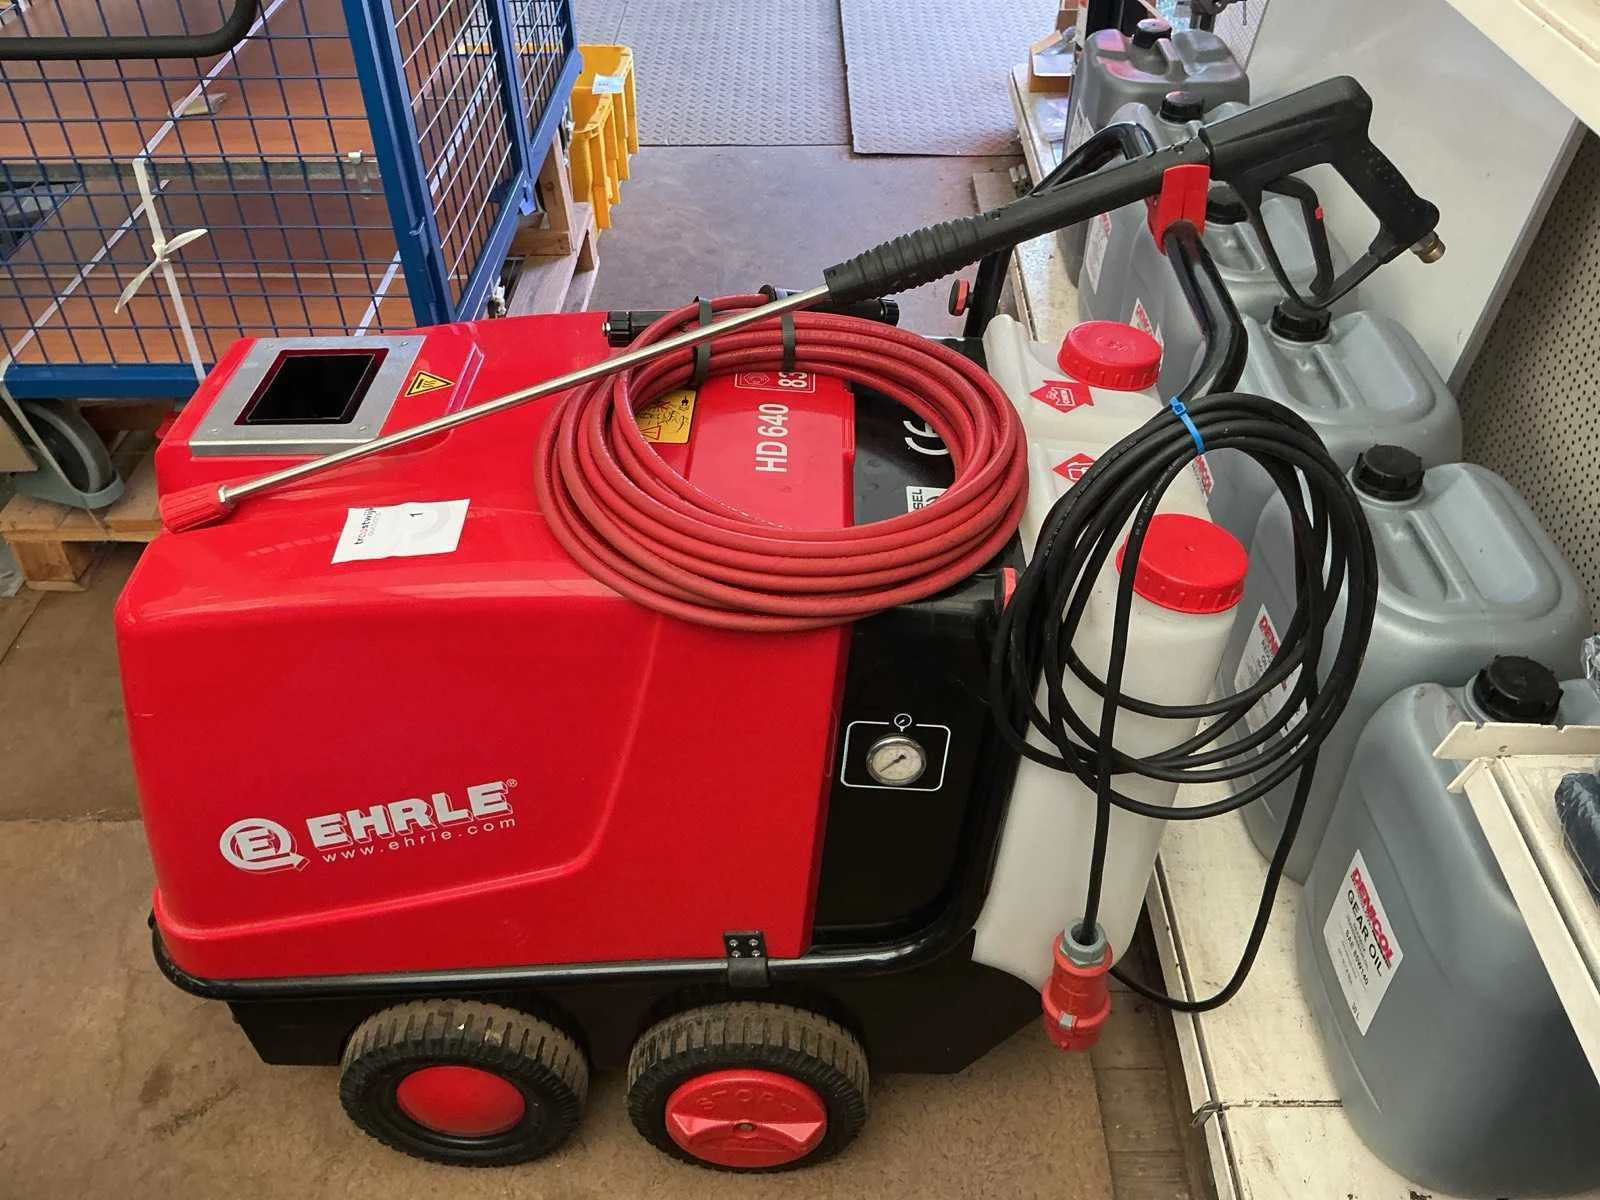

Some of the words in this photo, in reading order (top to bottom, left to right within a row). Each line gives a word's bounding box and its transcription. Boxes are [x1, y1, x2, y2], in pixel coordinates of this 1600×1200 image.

[757, 403, 790, 438] 640
[755, 441, 788, 473] HD
[306, 781, 512, 850] EHRLE
[322, 817, 516, 864] www.ehrle.com
[1347, 889, 1369, 942] GEAR
[1368, 943, 1382, 977] OIL
[1352, 866, 1393, 963] DENICOL
